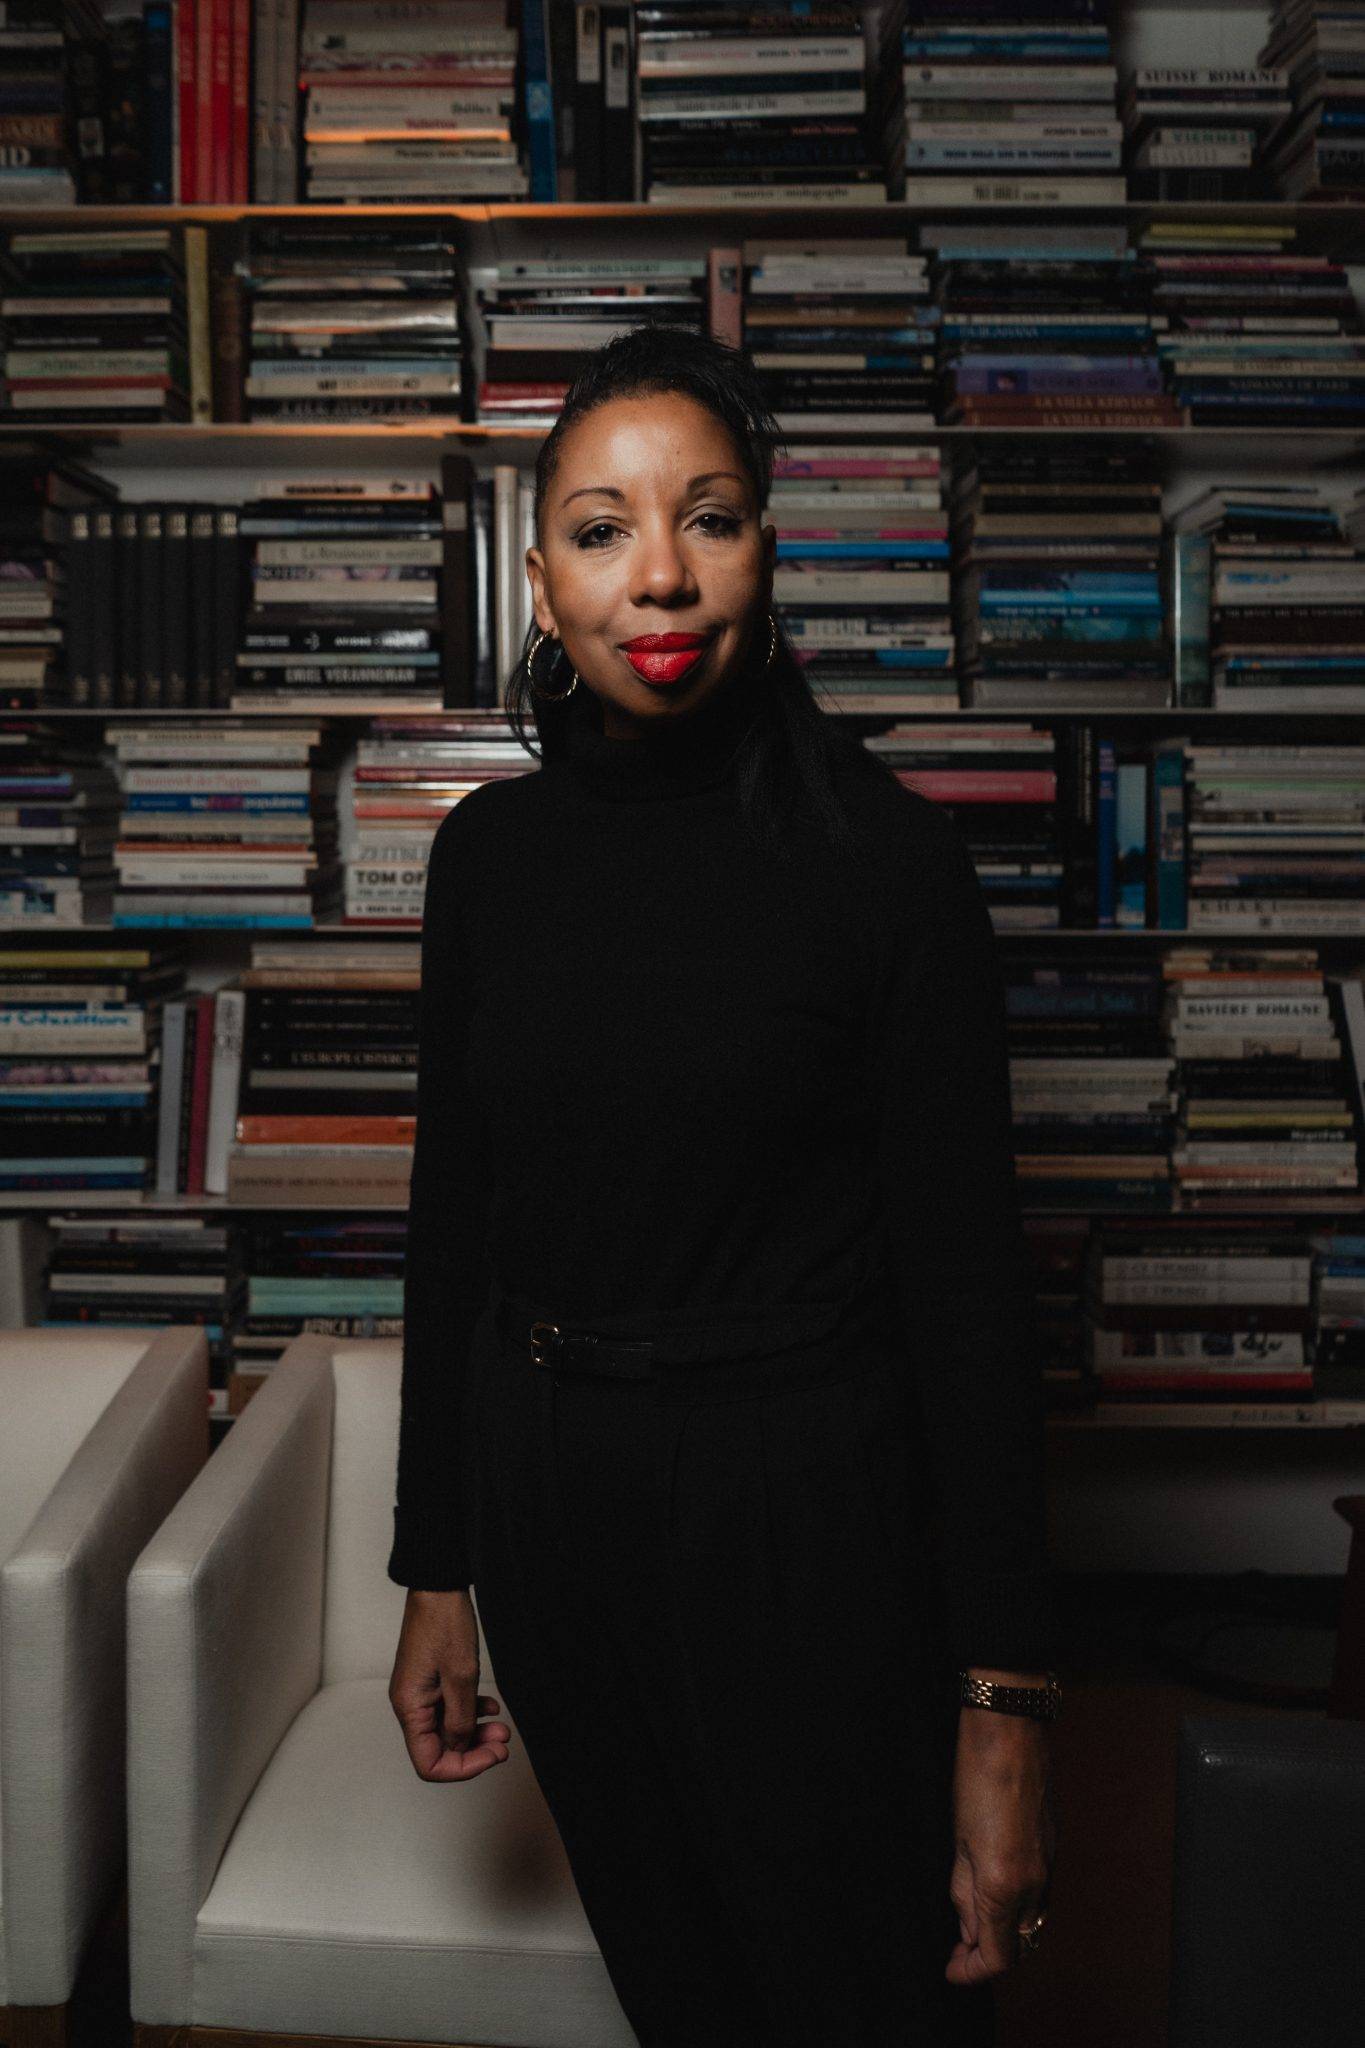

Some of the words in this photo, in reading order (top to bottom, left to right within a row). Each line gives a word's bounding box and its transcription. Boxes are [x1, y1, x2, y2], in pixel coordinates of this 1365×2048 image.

[1144, 70, 1197, 83] SUISSE
[1208, 70, 1279, 83] ROMANE
[356, 870, 397, 884] TOM
[402, 870, 424, 884] OF
